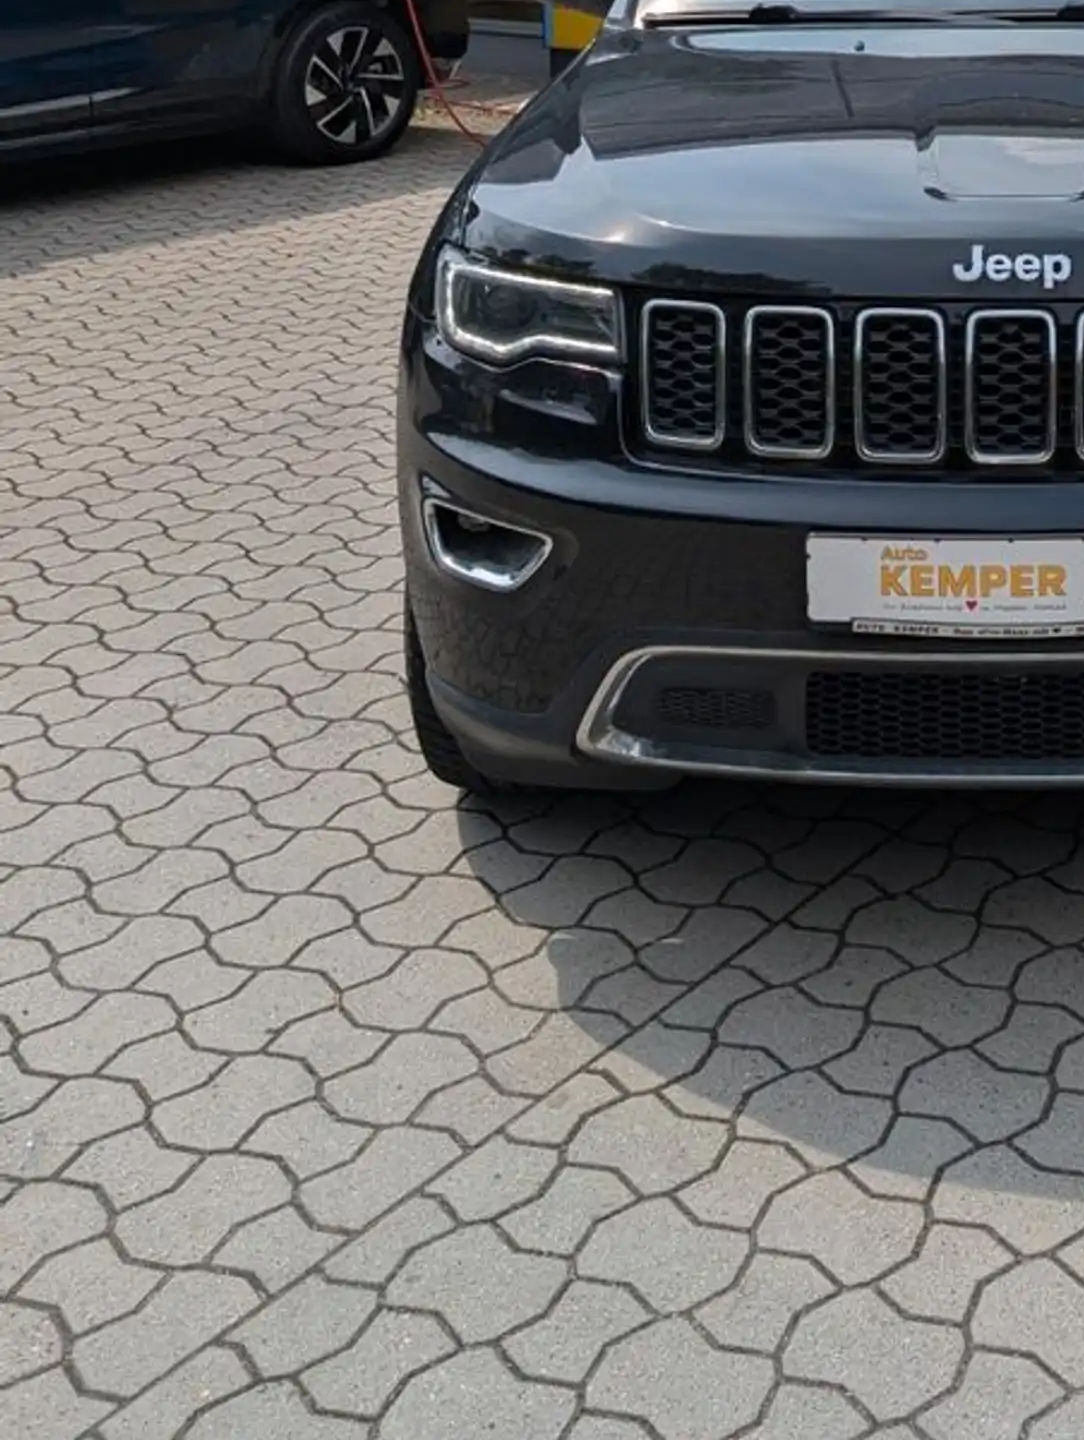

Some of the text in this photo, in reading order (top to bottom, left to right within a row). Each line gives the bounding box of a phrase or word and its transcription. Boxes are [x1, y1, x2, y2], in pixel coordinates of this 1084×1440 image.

[952, 244, 1072, 290] Jeep
[881, 545, 929, 561] Auto
[881, 564, 1068, 598] KEMPER
